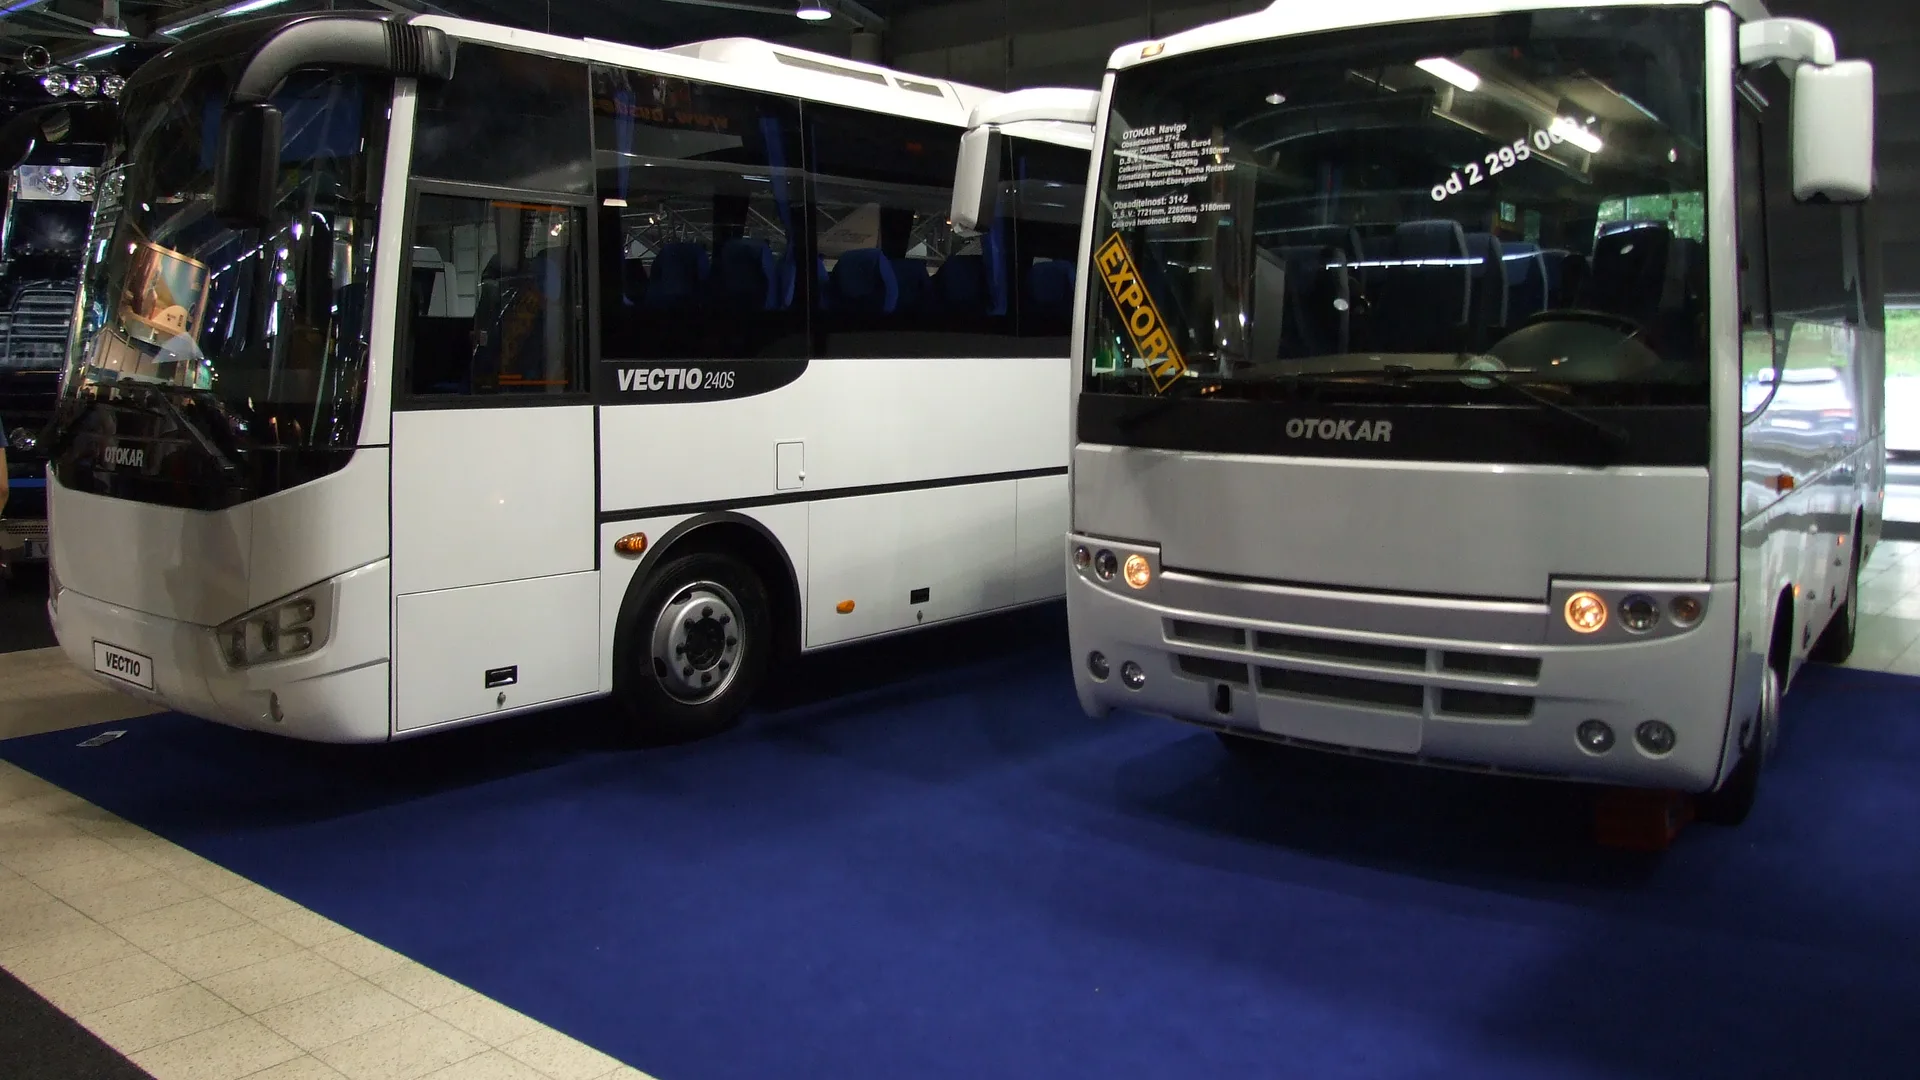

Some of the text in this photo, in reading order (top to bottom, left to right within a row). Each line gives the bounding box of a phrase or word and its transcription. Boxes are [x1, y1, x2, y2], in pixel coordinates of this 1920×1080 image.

[1123, 124, 1187, 140] OTOKAR Navigo
[1164, 133, 1180, 143] 27+2
[1192, 139, 1211, 147] Euro4
[1117, 163, 1236, 182] Klimatizace Konvekta, Telma Retarder
[1431, 171, 1463, 201] od
[1464, 162, 1484, 186] 2
[1485, 139, 1531, 175] 295
[1114, 194, 1189, 210] Obsaditelnost: 31+2
[1137, 206, 1166, 216] 7721mm,
[1167, 203, 1199, 214] 2265mm,
[1200, 202, 1231, 212] 3180mm
[1137, 216, 1170, 226] hmotnost:
[1171, 214, 1197, 224] 9900kg
[1100, 241, 1182, 378] EXPORT
[617, 368, 735, 391] VECTIO 240S
[1285, 418, 1393, 442] OTOKAR
[104, 446, 144, 467] OTOKAR
[106, 651, 141, 677] VECTIO
